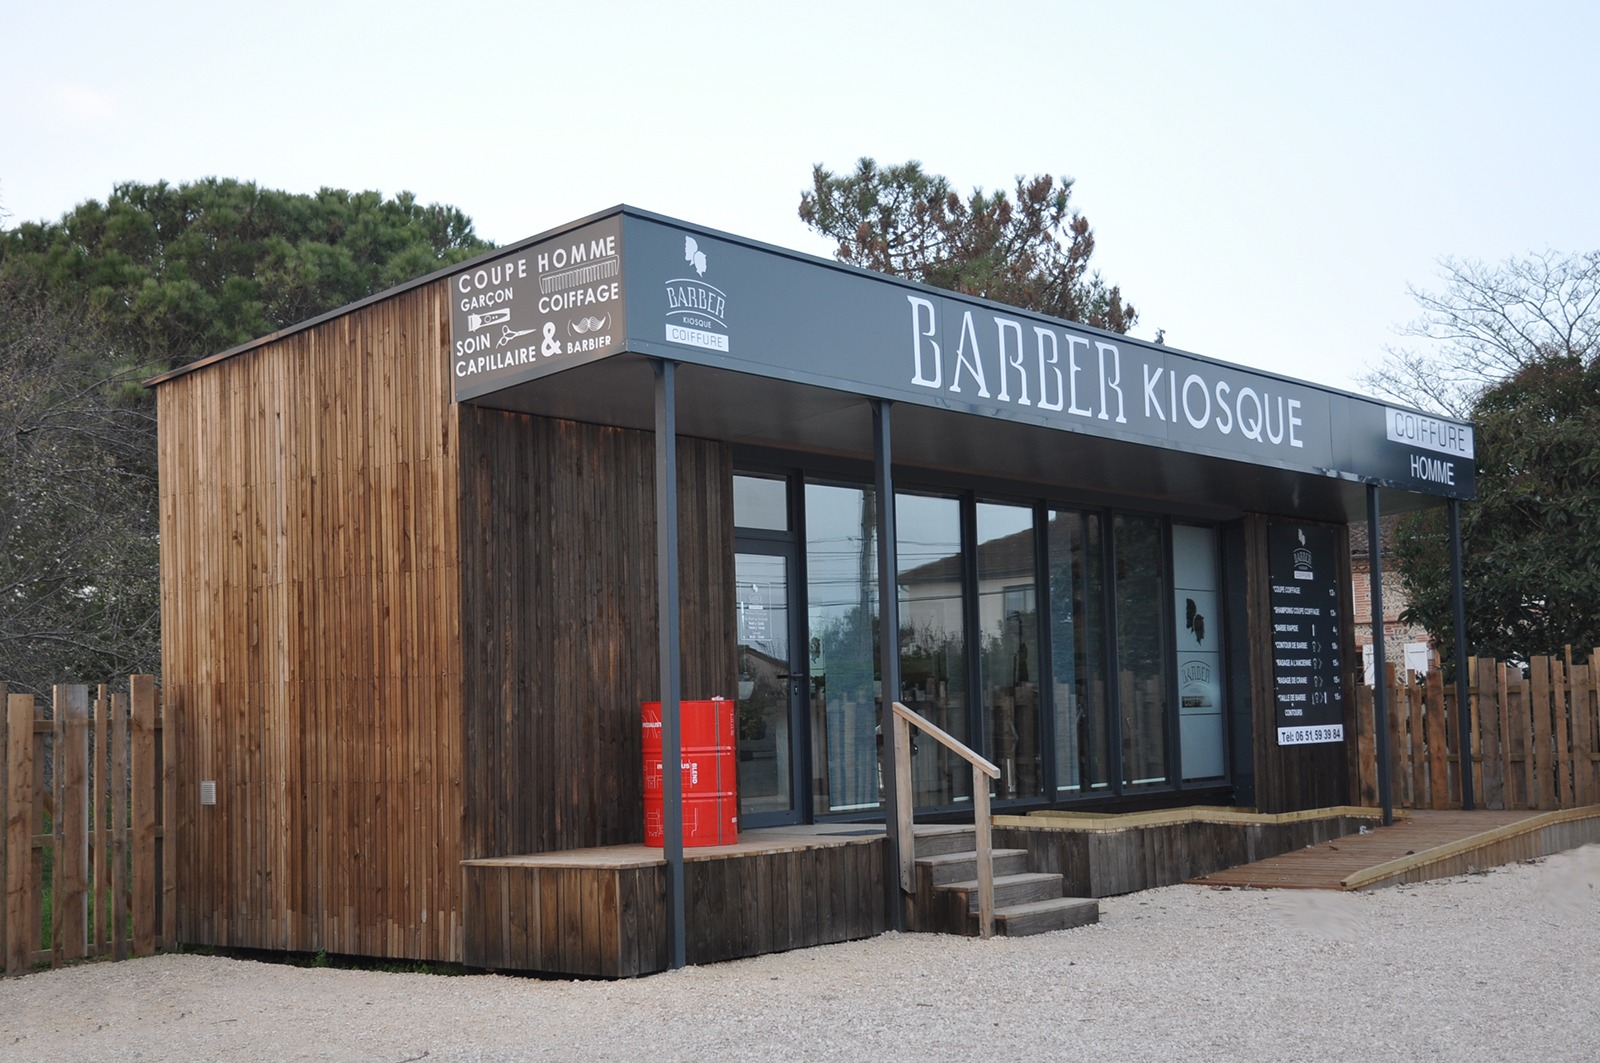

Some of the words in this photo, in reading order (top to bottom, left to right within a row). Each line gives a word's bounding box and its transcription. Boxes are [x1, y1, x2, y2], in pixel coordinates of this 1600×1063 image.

[459, 259, 527, 293] COUPE
[538, 236, 615, 273] HOMME
[461, 287, 513, 312] GARÇON
[538, 283, 619, 314] COIFFAGE
[666, 286, 725, 319] BARBER
[683, 316, 711, 328] KIOSQUE
[456, 333, 491, 357] SOIN
[541, 322, 562, 357] &
[567, 336, 611, 354] BARBIER
[672, 328, 723, 348] COIFFURE
[456, 346, 536, 377] CAPILLAIRE
[907, 295, 1127, 424] BARBER
[1143, 363, 1303, 448] KIOSQUE
[1394, 412, 1466, 452] COIFFURE
[1410, 454, 1455, 486] HOMME
[1295, 731, 1303, 741] 06
[1315, 730, 1322, 740] 59
[1324, 729, 1331, 739] 39
[1333, 729, 1340, 739] 84
